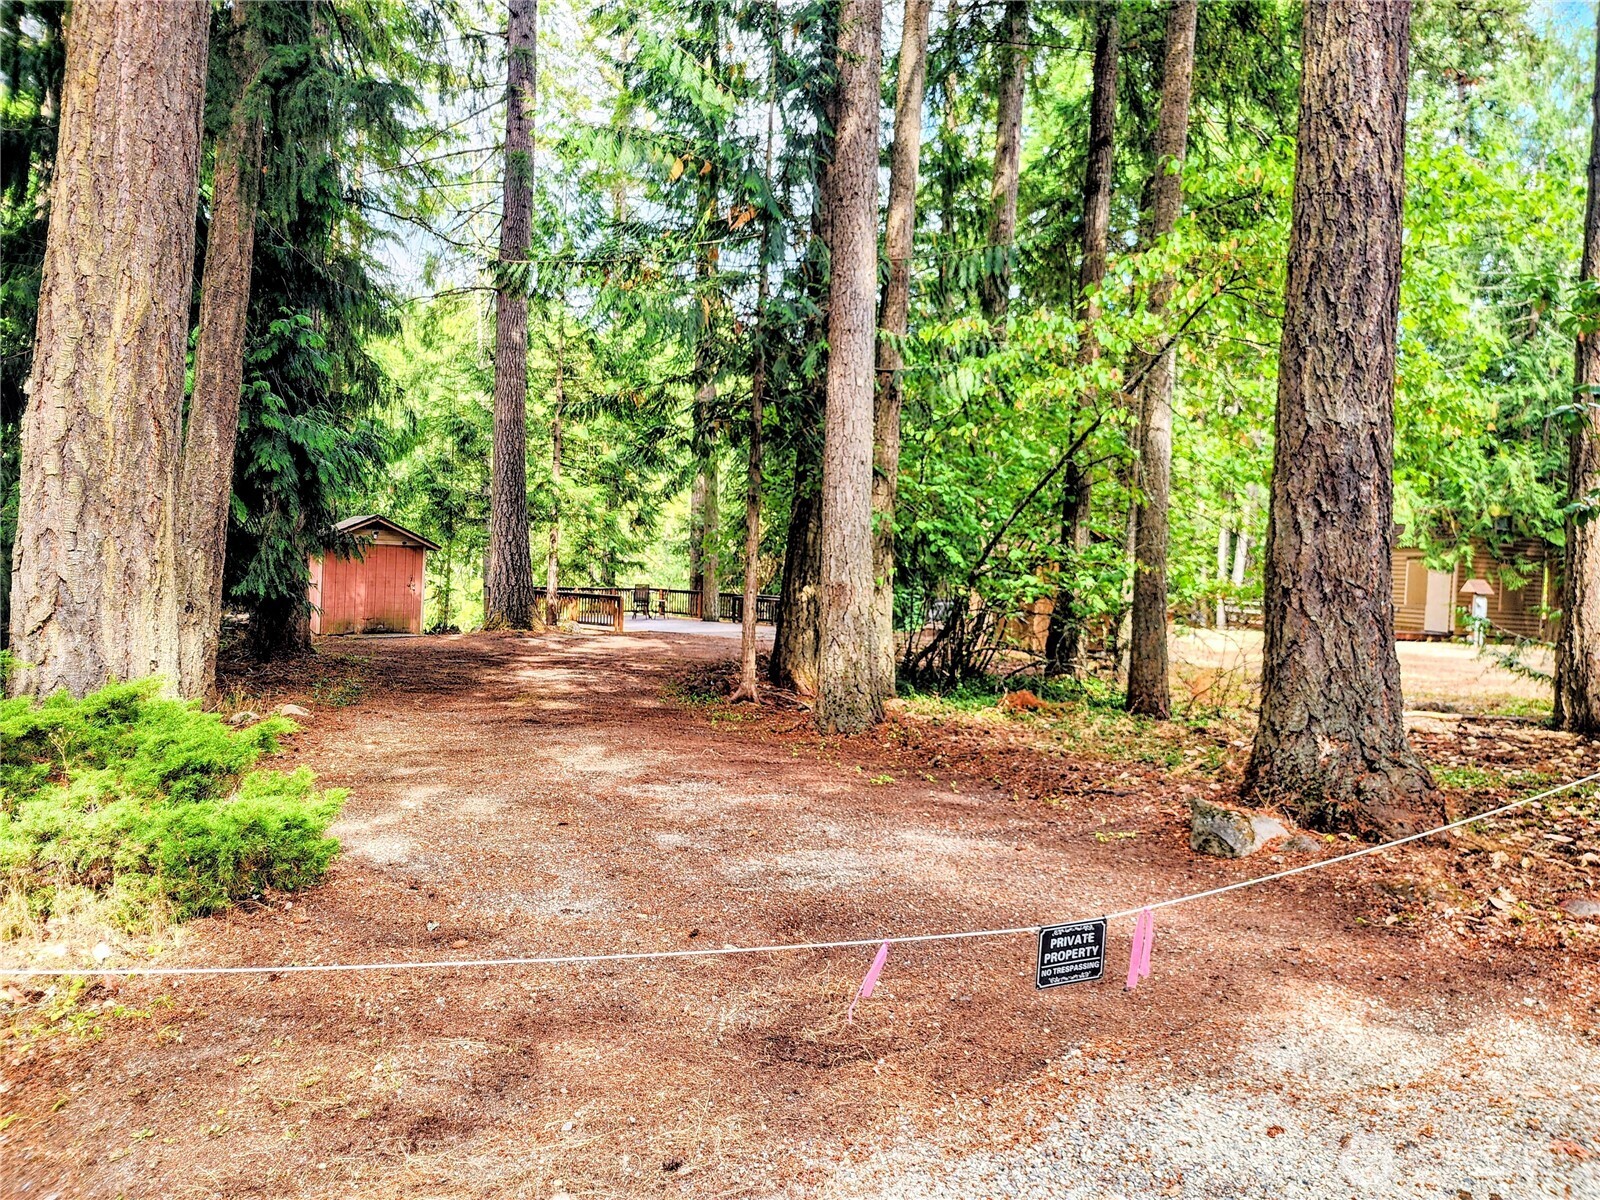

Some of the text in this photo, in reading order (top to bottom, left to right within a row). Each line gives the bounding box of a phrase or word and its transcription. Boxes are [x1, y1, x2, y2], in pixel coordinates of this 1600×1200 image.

[1050, 933, 1095, 949] PRIVATE
[1044, 945, 1099, 964] PROPERTY
[1041, 961, 1100, 977] NO TRESPASSING
